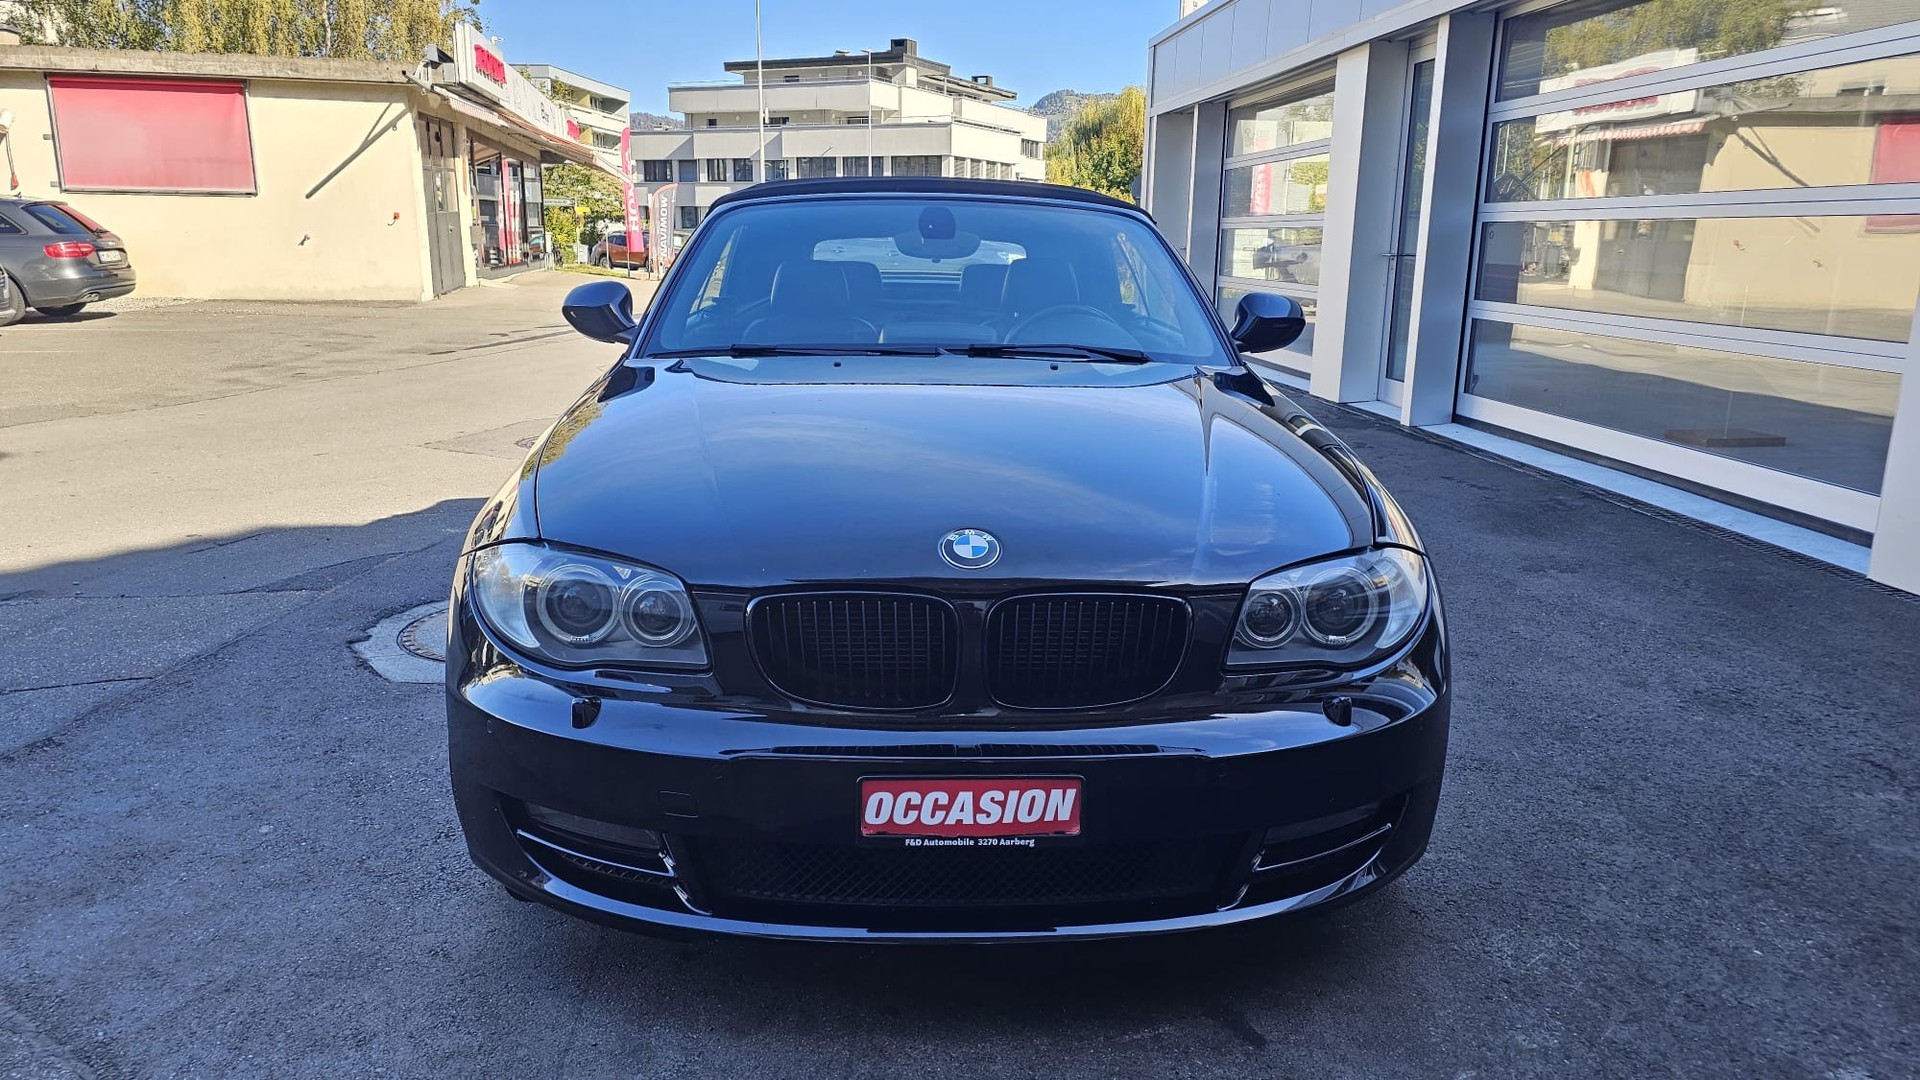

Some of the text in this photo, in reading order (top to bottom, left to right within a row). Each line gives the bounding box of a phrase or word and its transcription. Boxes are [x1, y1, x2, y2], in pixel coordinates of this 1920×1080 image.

[659, 195, 669, 258] NAVIMOW
[947, 529, 994, 541] BMW
[864, 788, 1077, 826] OCCASION
[905, 838, 1035, 847] F&D Automobile 3270 Aarberg
